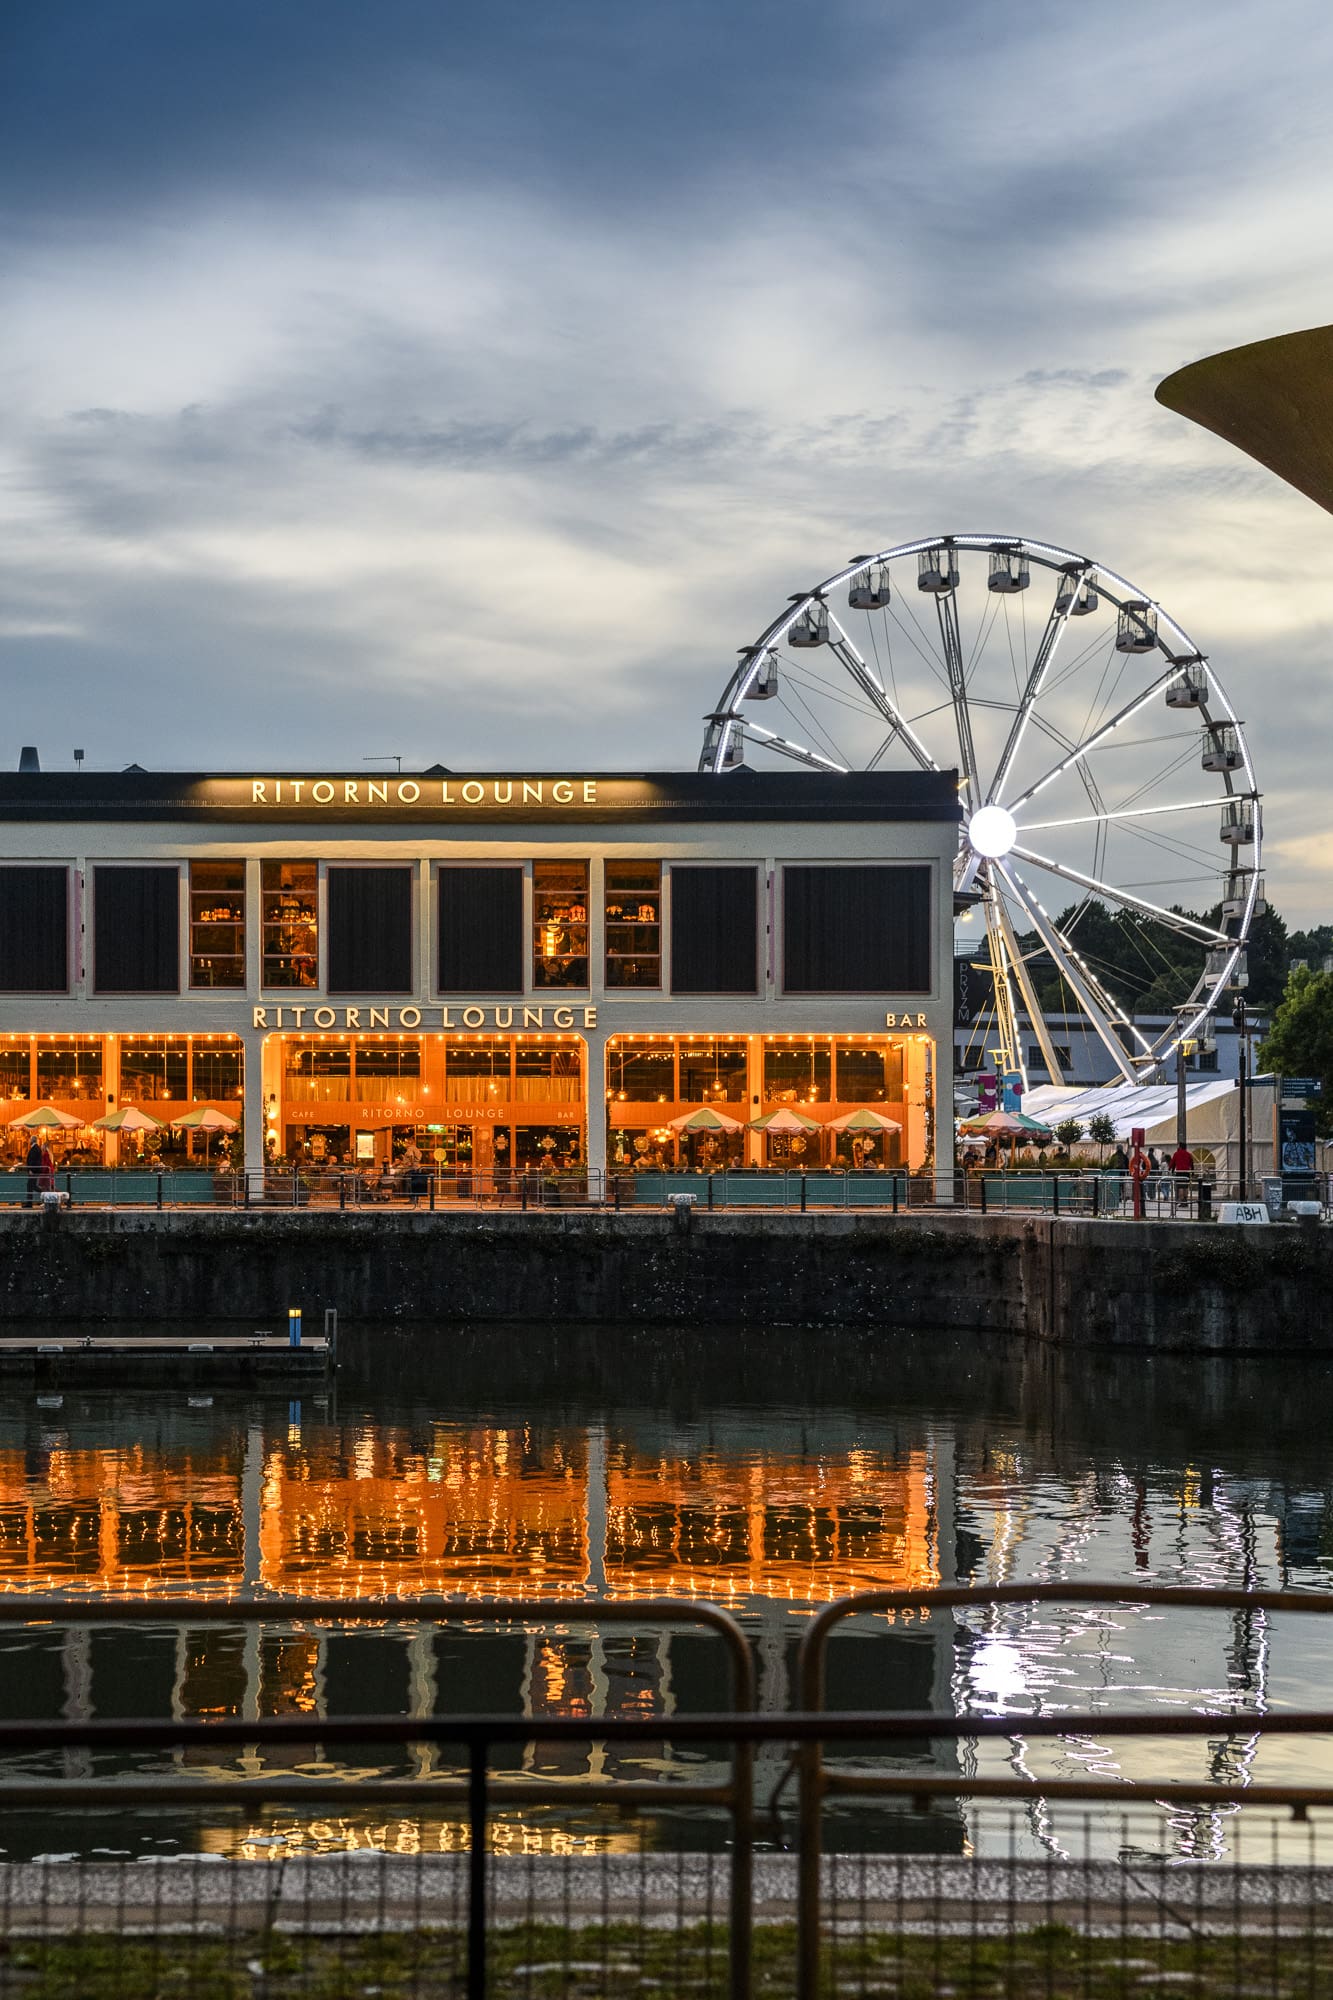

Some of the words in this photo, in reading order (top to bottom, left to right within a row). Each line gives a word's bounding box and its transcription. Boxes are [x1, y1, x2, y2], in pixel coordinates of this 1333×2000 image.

[251, 780, 421, 804] RITORNO
[442, 780, 597, 804] LOUNGE
[958, 962, 970, 1021] PRYZM
[252, 1005, 422, 1029] RITORNO
[443, 1005, 597, 1029] LOUNGE
[885, 1012, 928, 1027] BAR
[362, 1108, 425, 1118] RITORNO
[446, 1108, 505, 1119] LOUNGE
[557, 1111, 574, 1119] BAR
